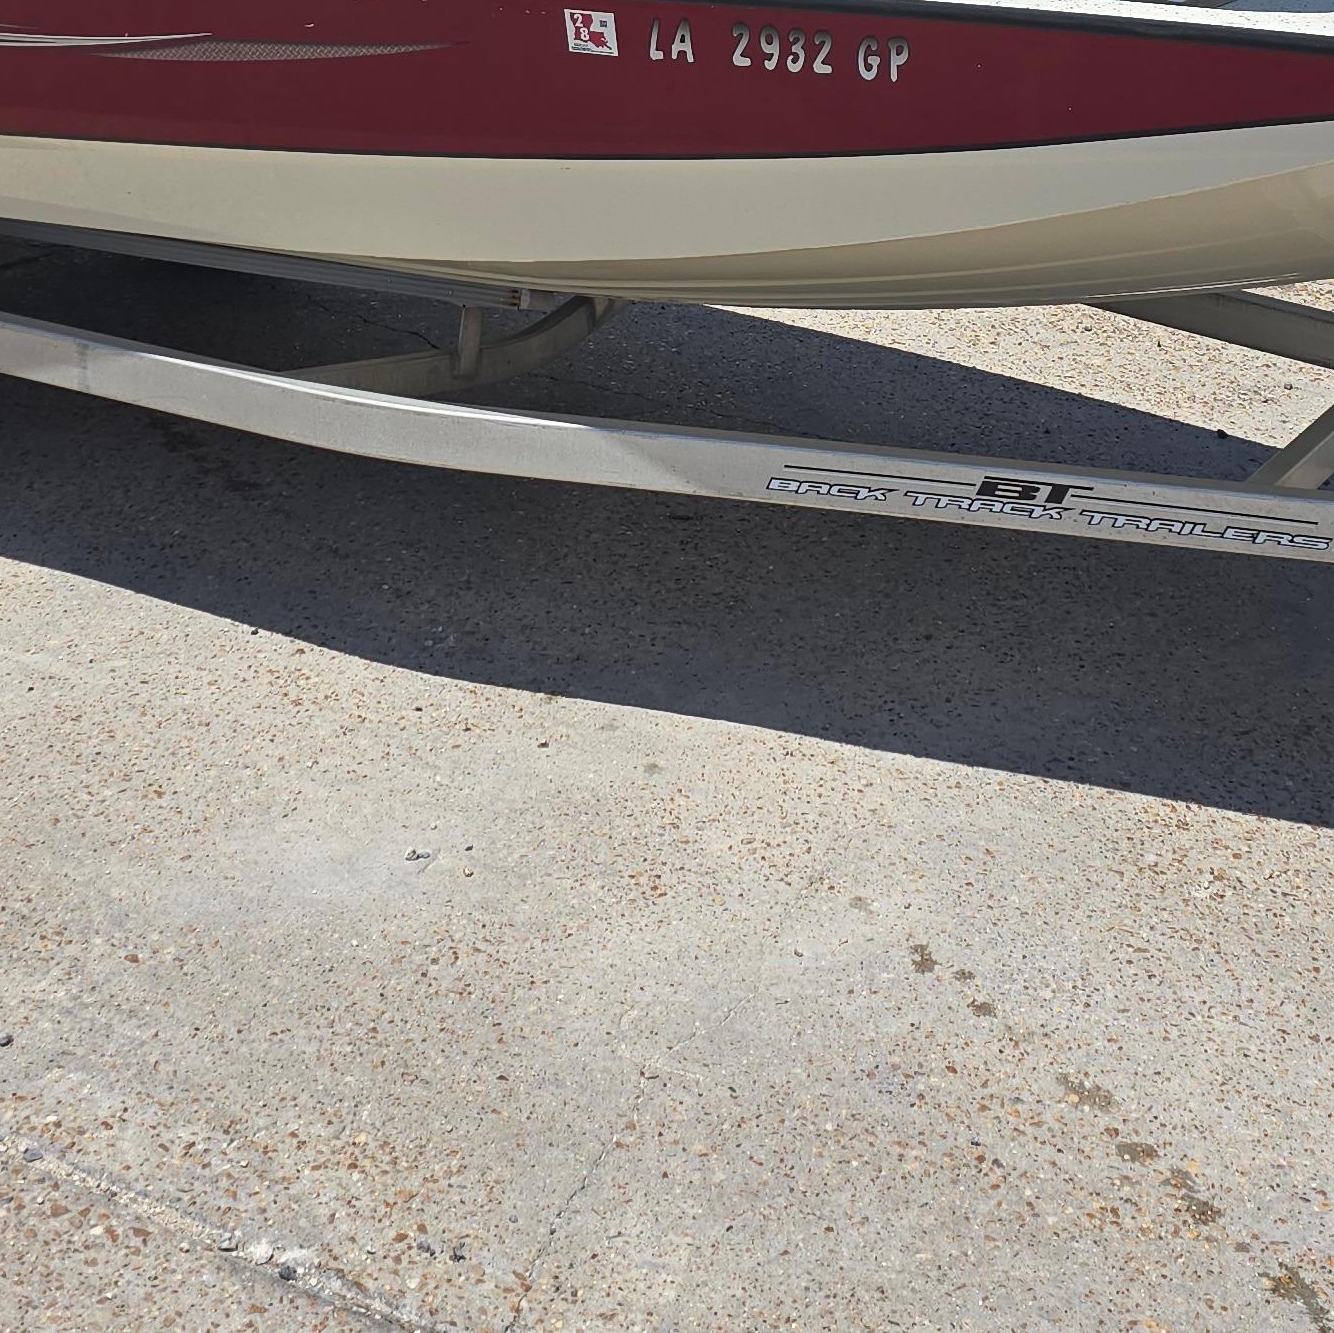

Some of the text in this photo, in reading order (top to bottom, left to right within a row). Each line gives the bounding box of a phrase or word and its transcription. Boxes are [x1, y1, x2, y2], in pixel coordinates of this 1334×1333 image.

[649, 17, 910, 83] LA 2932 GP
[766, 477, 1334, 551] BACK TRACK TRAILERS
[976, 476, 1094, 506] BT
